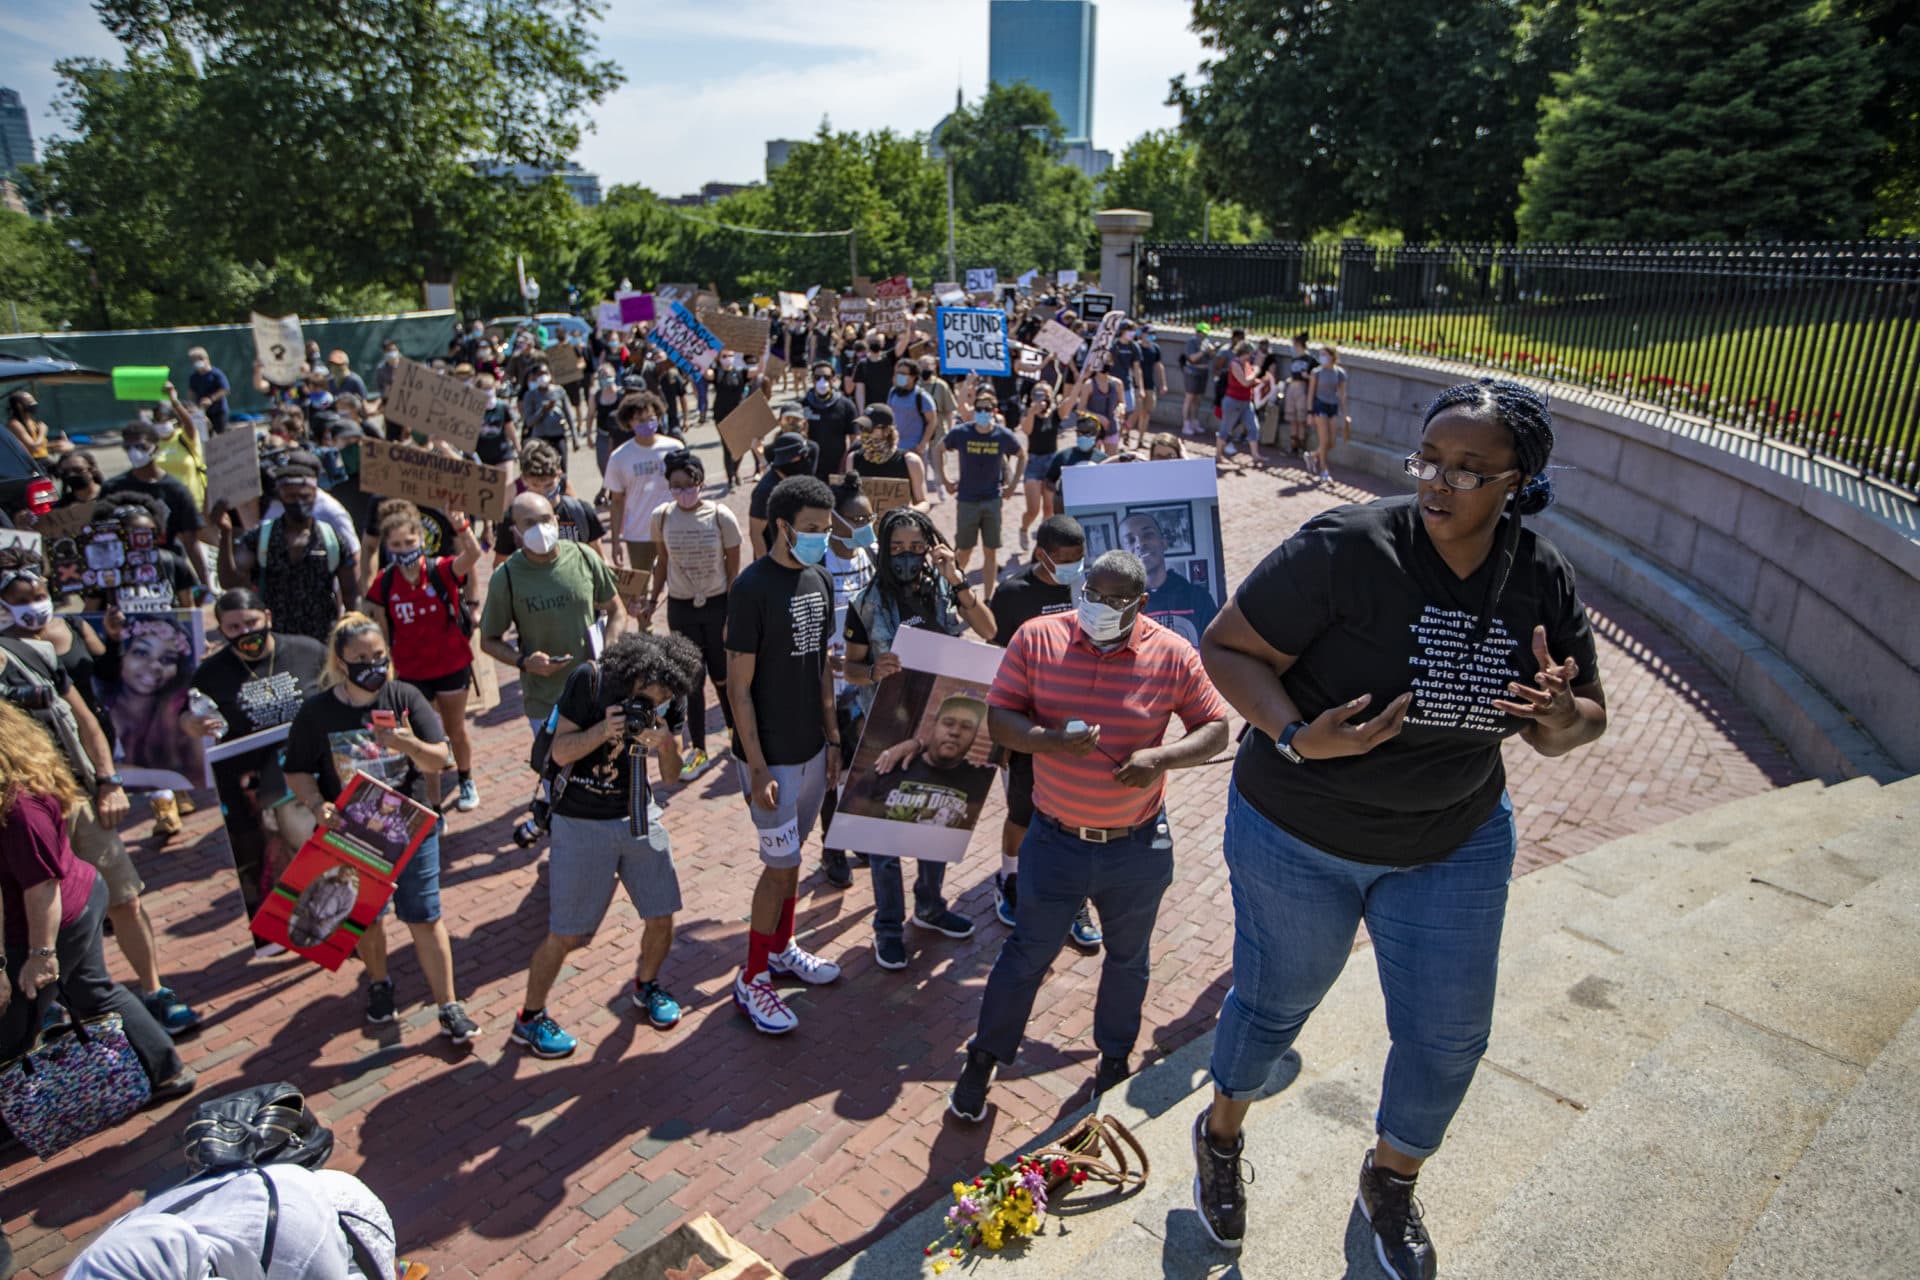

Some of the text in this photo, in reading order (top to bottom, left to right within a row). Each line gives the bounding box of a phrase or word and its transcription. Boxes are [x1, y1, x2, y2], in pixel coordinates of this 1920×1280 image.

[967, 270, 996, 289] BLM
[943, 313, 1001, 333] DEFUND
[962, 333, 985, 342] THE
[945, 339, 1004, 361] POLICE
[401, 362, 424, 390] No
[394, 389, 419, 418] No
[402, 468, 441, 485] WHERE
[401, 480, 417, 497] THE
[1420, 615, 1507, 637] Burrell Rsey
[1472, 642, 1511, 656] Taylor
[1408, 656, 1520, 678] Rayshrd Brooks
[1473, 653, 1506, 666] Floyd
[1428, 668, 1503, 686] Eric Garner
[1411, 677, 1517, 698] Andrew Kearse
[1415, 688, 1473, 703] Stephon
[1416, 699, 1466, 712] Sandra
[1470, 705, 1505, 717] Bland
[1422, 709, 1495, 724] Tamir Rice
[1403, 715, 1506, 733] Ahmaud Arbery
